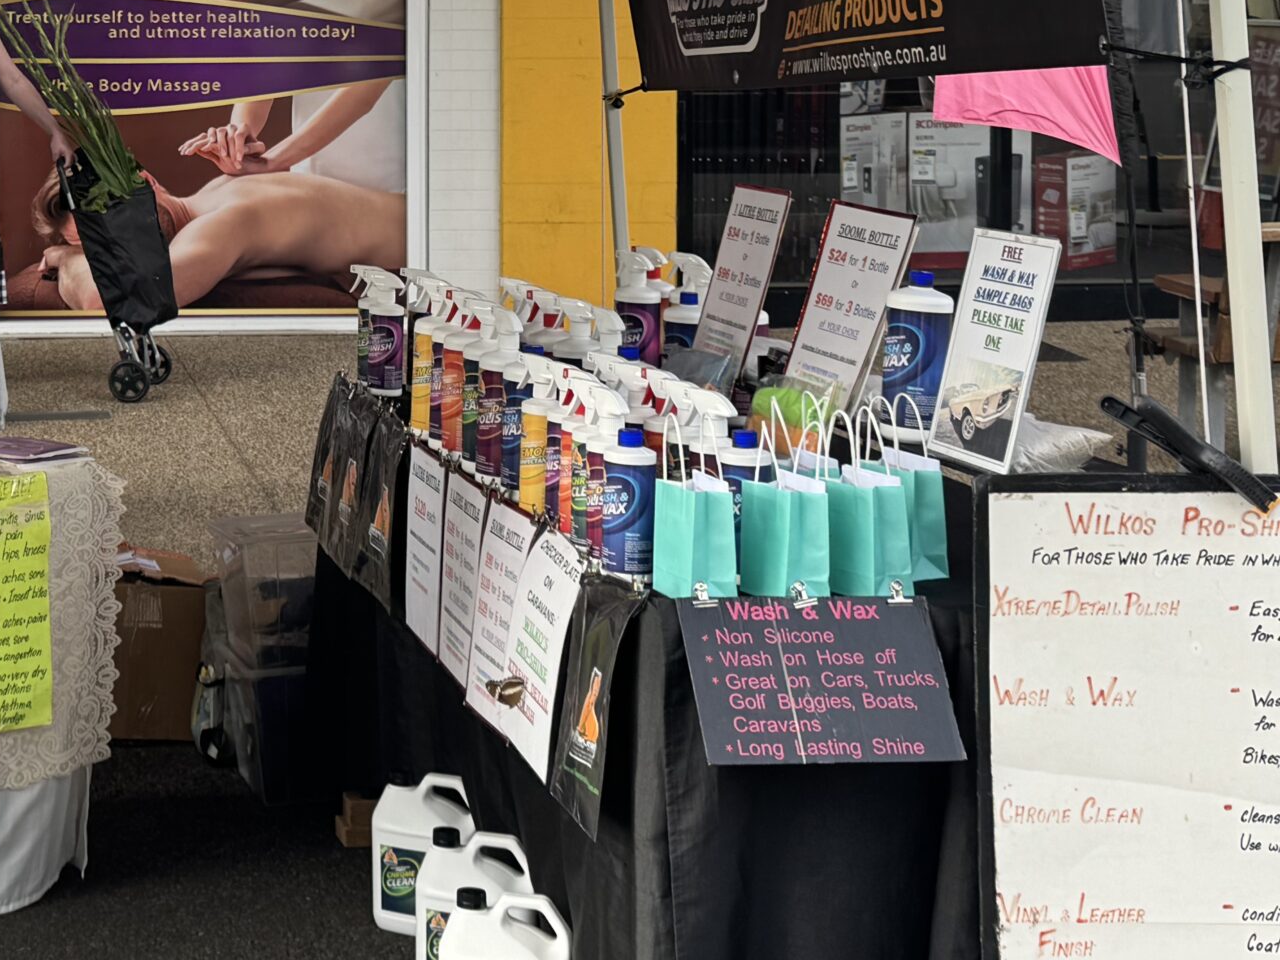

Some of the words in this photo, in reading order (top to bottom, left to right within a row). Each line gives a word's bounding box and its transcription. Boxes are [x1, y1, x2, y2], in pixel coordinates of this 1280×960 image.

[7, 10, 49, 24] Treat
[127, 12, 144, 24] to
[149, 11, 204, 24] better
[207, 10, 260, 24] health
[726, 11, 746, 26] pride
[785, 2, 841, 41] DETAILING
[108, 26, 141, 39] and
[145, 27, 205, 39] utmost
[211, 25, 296, 39] relaxation
[301, 25, 356, 41] today!
[729, 26, 748, 38] drive
[99, 79, 142, 96] Body
[147, 79, 221, 96] Massage
[738, 205, 757, 218] LITRE
[756, 208, 780, 222] BOTTLE
[754, 232, 770, 246] Bottle
[838, 223, 867, 242] 500ML
[868, 229, 901, 247] BOTTLE
[828, 248, 847, 264] $24
[849, 254, 859, 265] for
[869, 259, 889, 274] Bottle
[1002, 245, 1024, 260] FREE
[982, 264, 1008, 280] WASH
[1017, 270, 1038, 286] WAX
[816, 293, 833, 309] $69
[835, 299, 844, 310] for
[853, 304, 876, 321] Bottles
[974, 287, 1010, 304] SAMPLE
[1011, 294, 1034, 310] BAGS
[971, 309, 1004, 327] PLEASE
[1005, 316, 1026, 332] TAKE
[985, 335, 1002, 349] ONE
[1065, 502, 1156, 536] WILKOS
[506, 528, 526, 550] BOTTLE
[540, 539, 563, 568] CHECKER
[560, 554, 580, 583] PLATE
[1032, 547, 1061, 566] FOR
[1063, 547, 1116, 565] THOSE
[1118, 551, 1148, 566] WHO
[1153, 549, 1191, 566] TAKE
[1195, 548, 1235, 566] PRIDE
[1242, 553, 1259, 566] IN
[544, 575, 554, 591] ON
[725, 601, 790, 622] Wash
[802, 605, 819, 621] &
[828, 599, 880, 620] Wax
[1123, 592, 1181, 617] POLISH
[716, 628, 753, 645] Non
[764, 628, 835, 645] Silicone
[1250, 624, 1273, 643] for
[719, 650, 773, 668] Wash
[783, 653, 807, 666] on
[817, 649, 865, 666] Hose
[875, 648, 897, 665] off
[725, 673, 778, 691] Great
[789, 675, 811, 689] on
[820, 672, 869, 690] Cars,
[873, 670, 940, 689] Trucks,
[993, 675, 1050, 707] WASH
[1087, 675, 1137, 708] WAX
[728, 693, 767, 711] Golf
[777, 693, 856, 714] Buggies,
[863, 693, 919, 711] Boats,
[732, 716, 822, 734] Caravans
[1254, 715, 1276, 732] for
[736, 739, 784, 761] Long
[795, 739, 863, 760] Lasting
[872, 738, 926, 756] Shine
[999, 797, 1072, 824] CHROME
[1080, 796, 1144, 825] CLEAN
[1240, 832, 1262, 852] Use
[387, 878, 416, 888] CLEAN
[1076, 892, 1146, 924] LEATHER
[1038, 928, 1096, 957] FINISH
